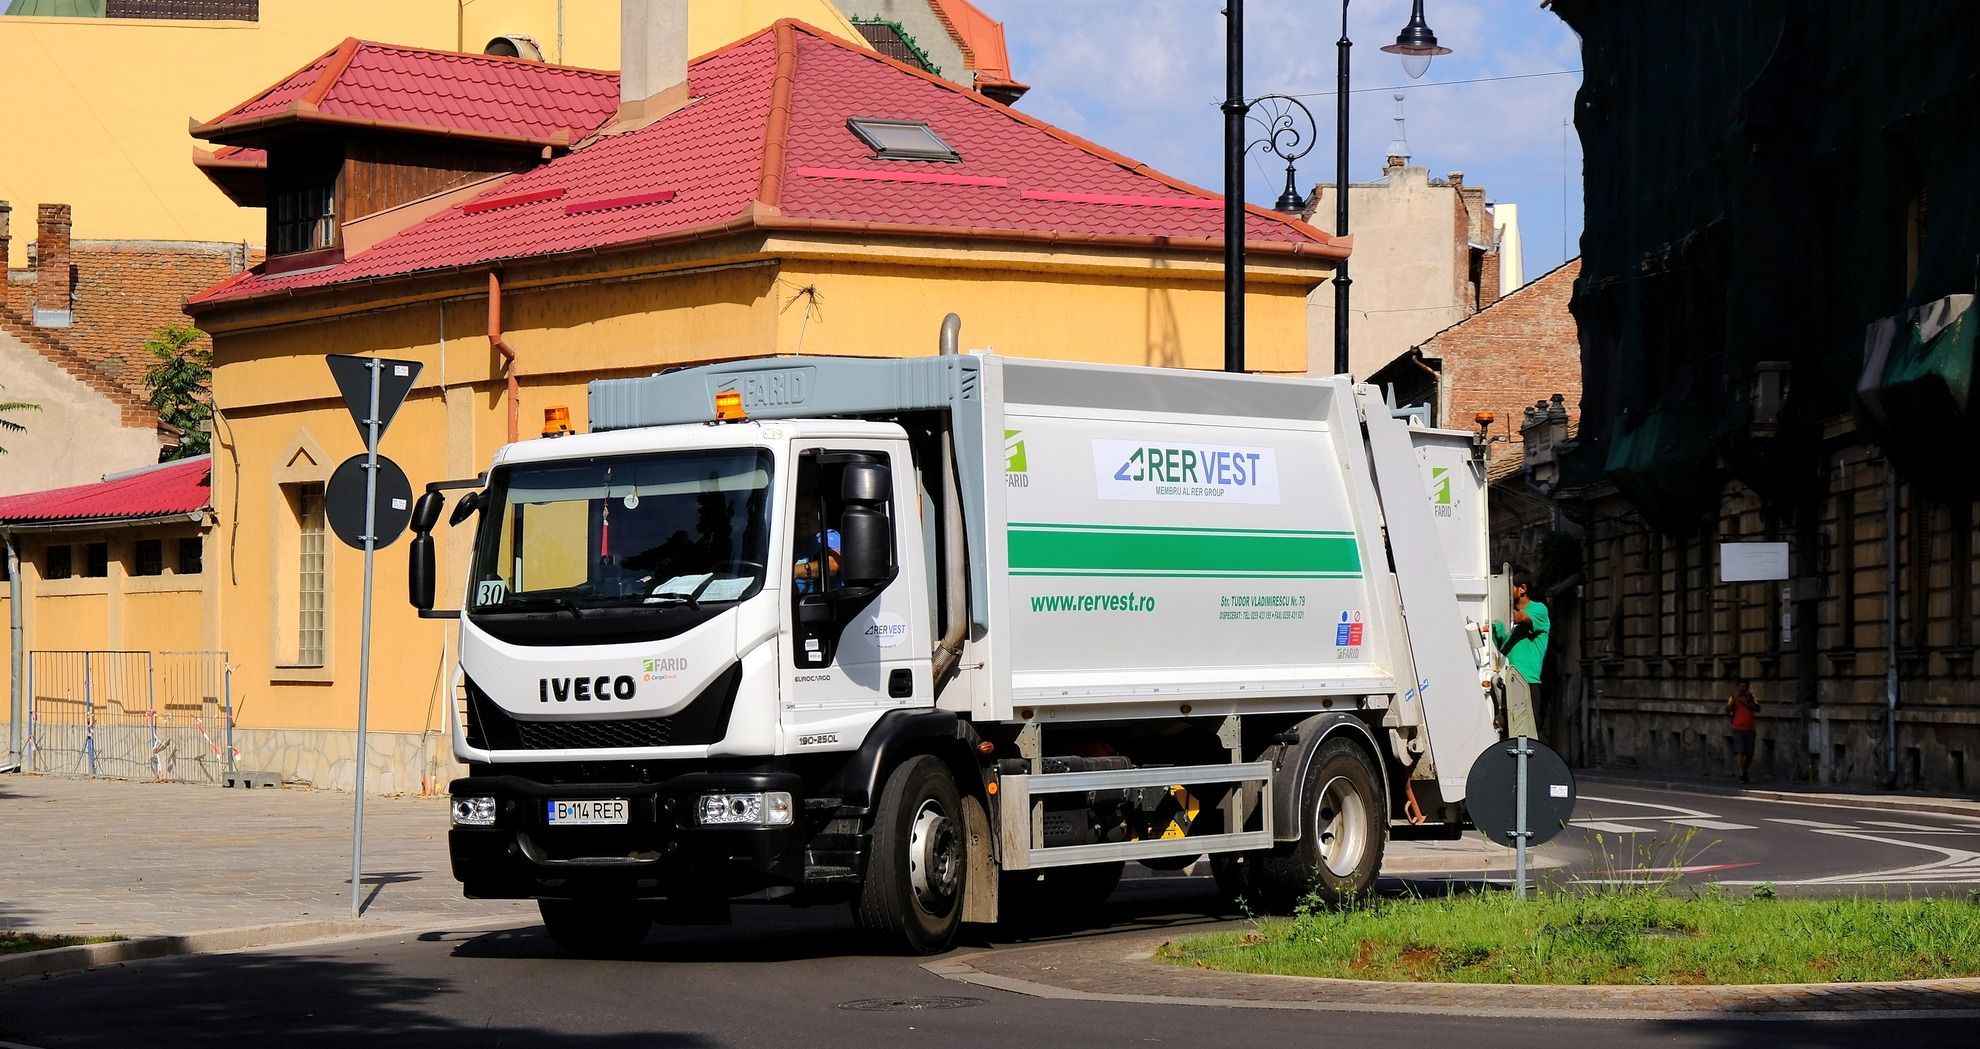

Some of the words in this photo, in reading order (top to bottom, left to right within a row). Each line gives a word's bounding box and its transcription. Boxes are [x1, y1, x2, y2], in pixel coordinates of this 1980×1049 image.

[745, 372, 806, 407] FARID
[1156, 486, 1182, 496] MEMBRU
[1182, 486, 1190, 496] AL
[1191, 487, 1203, 496] RER
[1204, 488, 1225, 497] GROUP
[1434, 505, 1452, 518] FARID
[481, 583, 501, 606] 30
[1231, 595, 1250, 607] TUDOR
[1251, 595, 1290, 607] VLADIMIRESCU
[1299, 595, 1305, 607] 79
[1030, 591, 1156, 613] www.rervest.ro
[1342, 648, 1360, 659] FARID
[654, 657, 688, 671] FARID
[794, 674, 831, 682] EUROCARGO
[539, 675, 638, 703] IVECO
[799, 734, 839, 745] 190-250L
[558, 803, 568, 819] B
[573, 803, 589, 819] 114
[593, 802, 624, 819] RER
